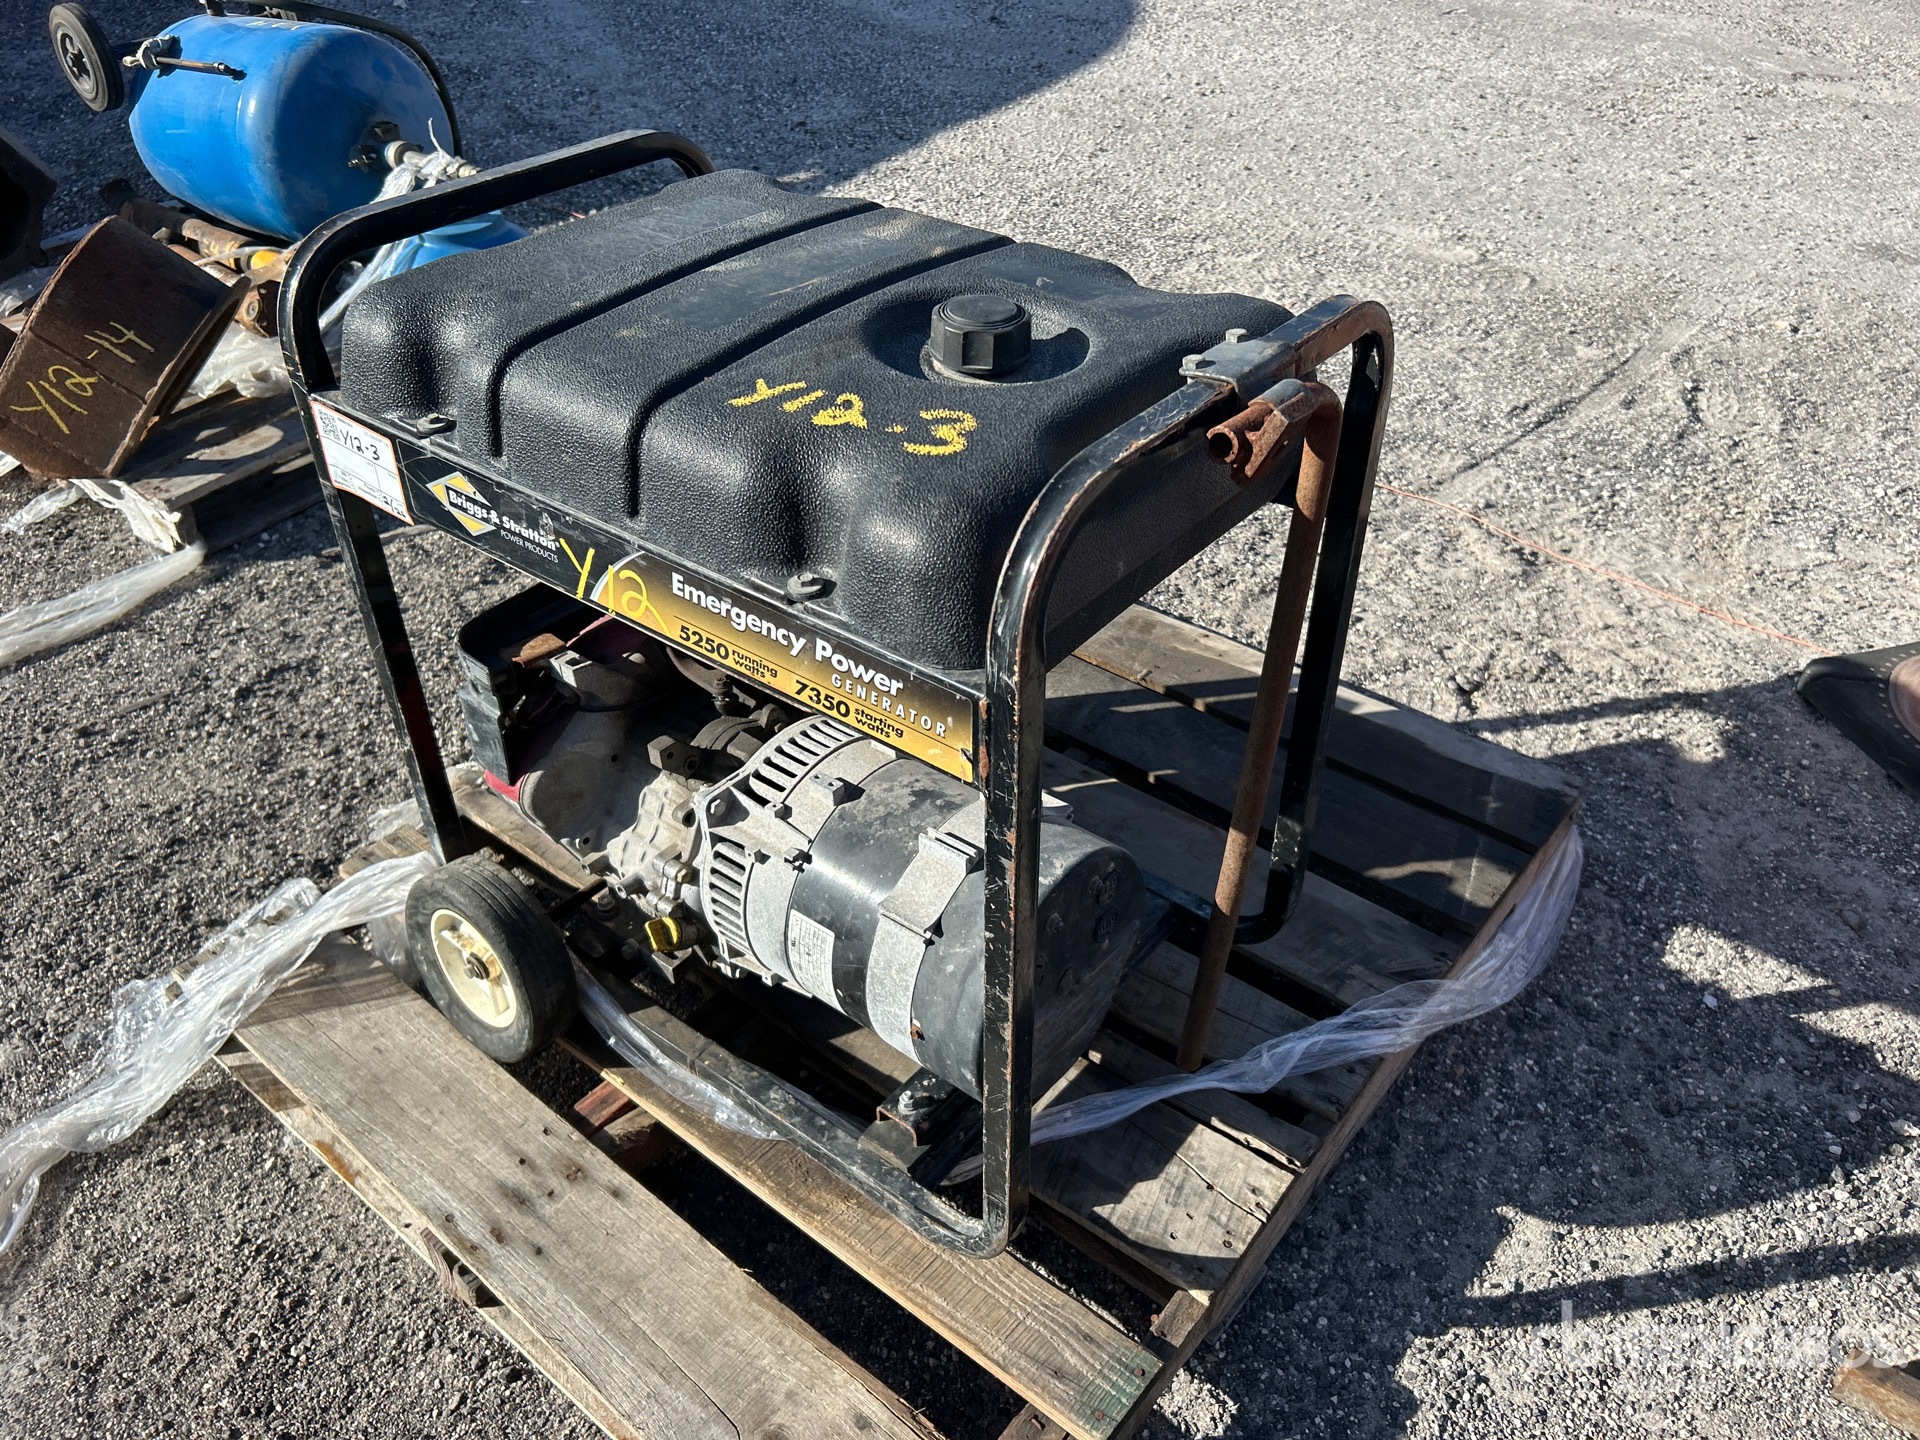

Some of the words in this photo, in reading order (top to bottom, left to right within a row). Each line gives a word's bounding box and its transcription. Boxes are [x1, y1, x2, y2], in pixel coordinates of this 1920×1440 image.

[10, 322, 155, 434] Y12-14
[339, 429, 381, 461] Y12-3
[448, 489, 488, 518] Briggs
[488, 510, 502, 526] &
[500, 529, 525, 547] POWER
[524, 540, 559, 563] PRODUCTS
[559, 537, 671, 636] Y12
[671, 572, 807, 658] Emergency
[814, 638, 904, 698] Power
[679, 625, 730, 661] 5250
[732, 649, 779, 679] running
[732, 658, 767, 680] watts
[794, 680, 851, 718] 7350
[831, 673, 947, 739] GENERATOR
[853, 706, 904, 739] starting
[854, 714, 892, 739] watts
